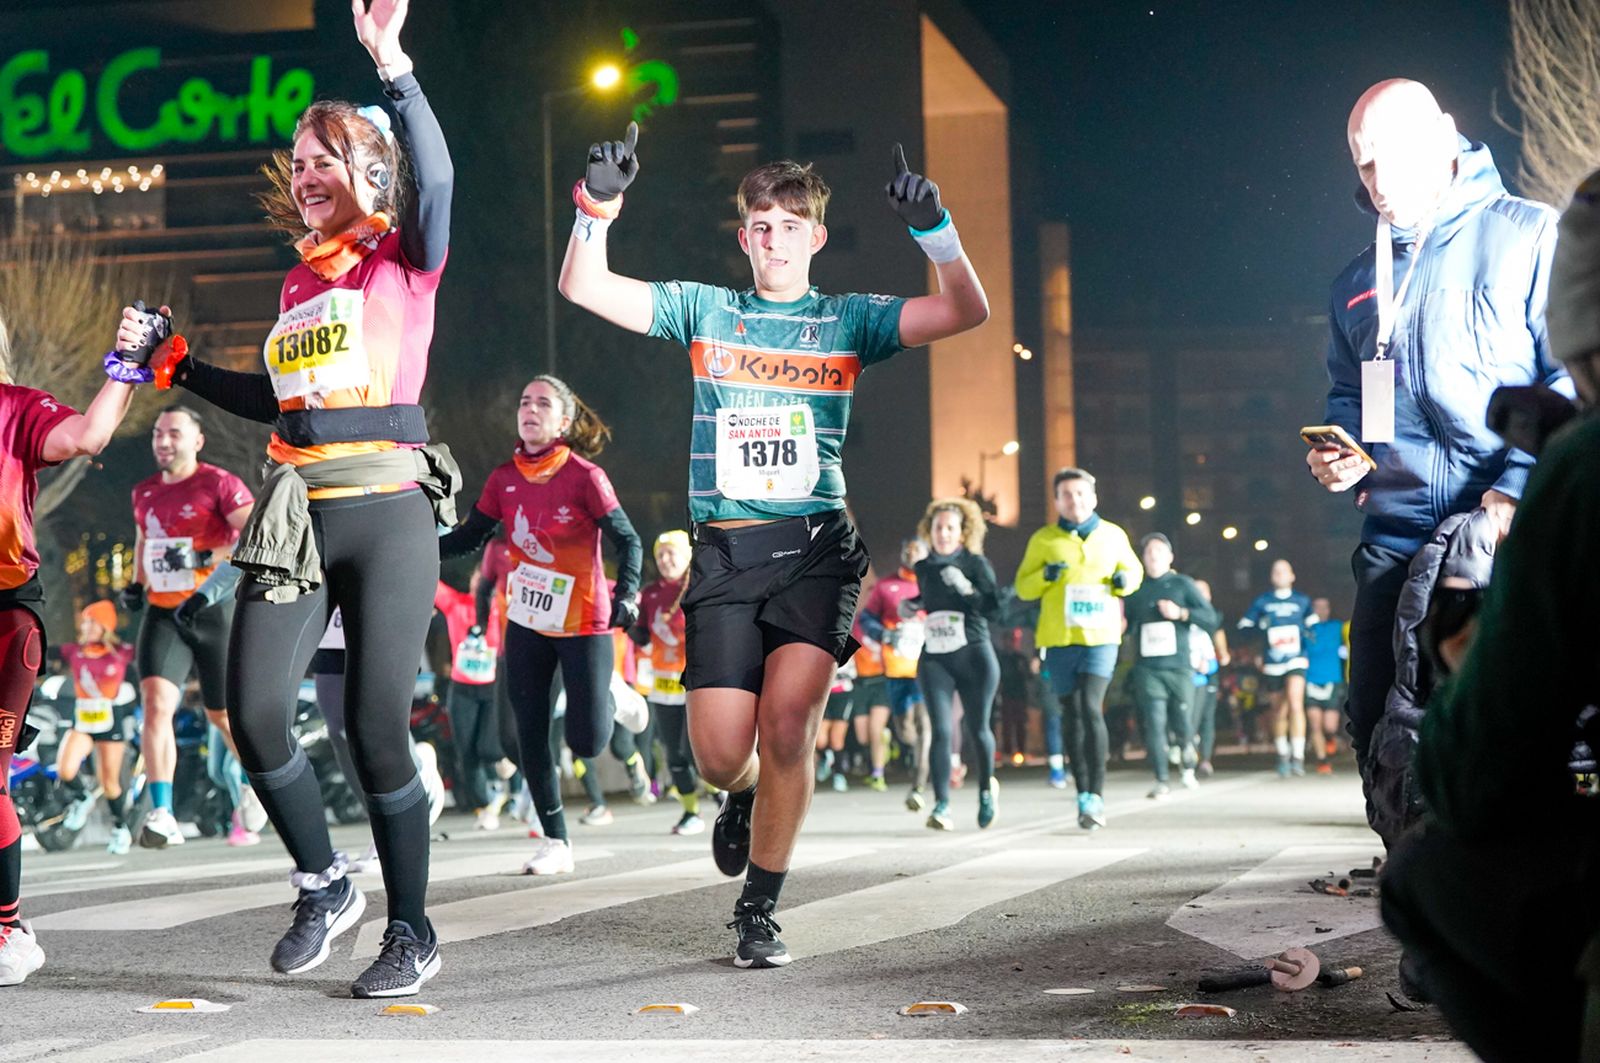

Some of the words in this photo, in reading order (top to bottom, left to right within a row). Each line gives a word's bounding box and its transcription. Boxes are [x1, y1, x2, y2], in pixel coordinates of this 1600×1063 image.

[0, 49, 91, 157] El
[96, 46, 314, 151] Corte
[276, 323, 349, 364] 13082
[739, 354, 843, 386] Kubota
[728, 429, 746, 440] SAN
[748, 428, 781, 439] ANTON
[738, 417, 766, 427] NOCHE
[768, 416, 780, 426] DE
[738, 438, 798, 467] 1378
[520, 587, 554, 612] 6170
